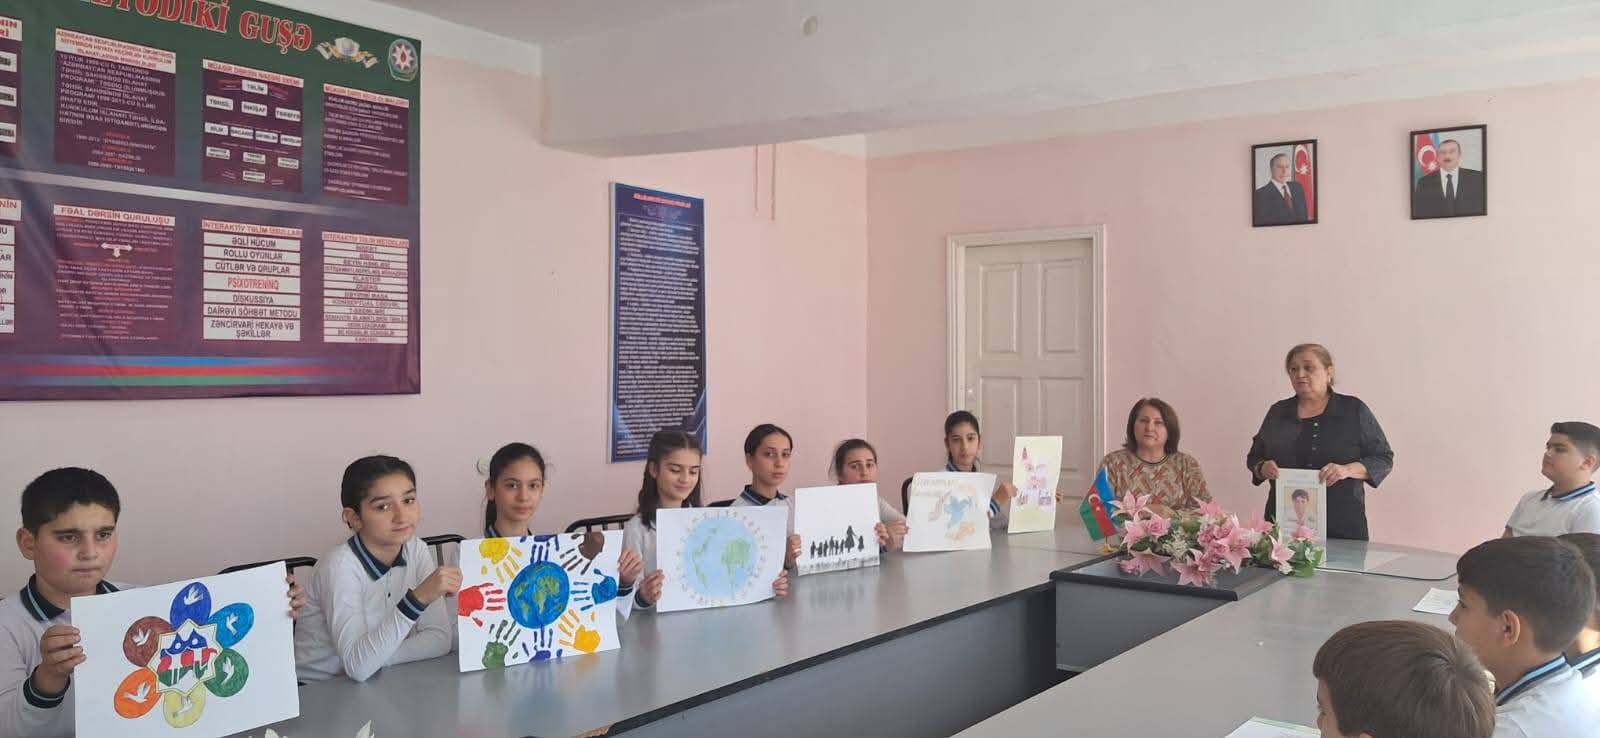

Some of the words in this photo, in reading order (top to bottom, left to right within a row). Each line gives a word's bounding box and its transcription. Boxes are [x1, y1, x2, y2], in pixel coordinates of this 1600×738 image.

[239, 10, 312, 54] GUŞƏ
[61, 207, 86, 216] FƏAL
[88, 209, 120, 219] DƏRSİN
[123, 213, 169, 224] QURULUŞU
[231, 236, 249, 246] ƏQLİ
[223, 248, 249, 259] ROLLU
[249, 251, 283, 261] OYUNLAR
[246, 263, 257, 272] VƏ
[257, 264, 290, 274] QRUPLAR
[207, 304, 237, 316] DAİRƏVİ
[269, 308, 298, 318] METODU
[255, 321, 284, 330] HEKAYƏ
[285, 322, 295, 330] VƏ
[235, 329, 271, 338] ŞƏKİLLƏR
